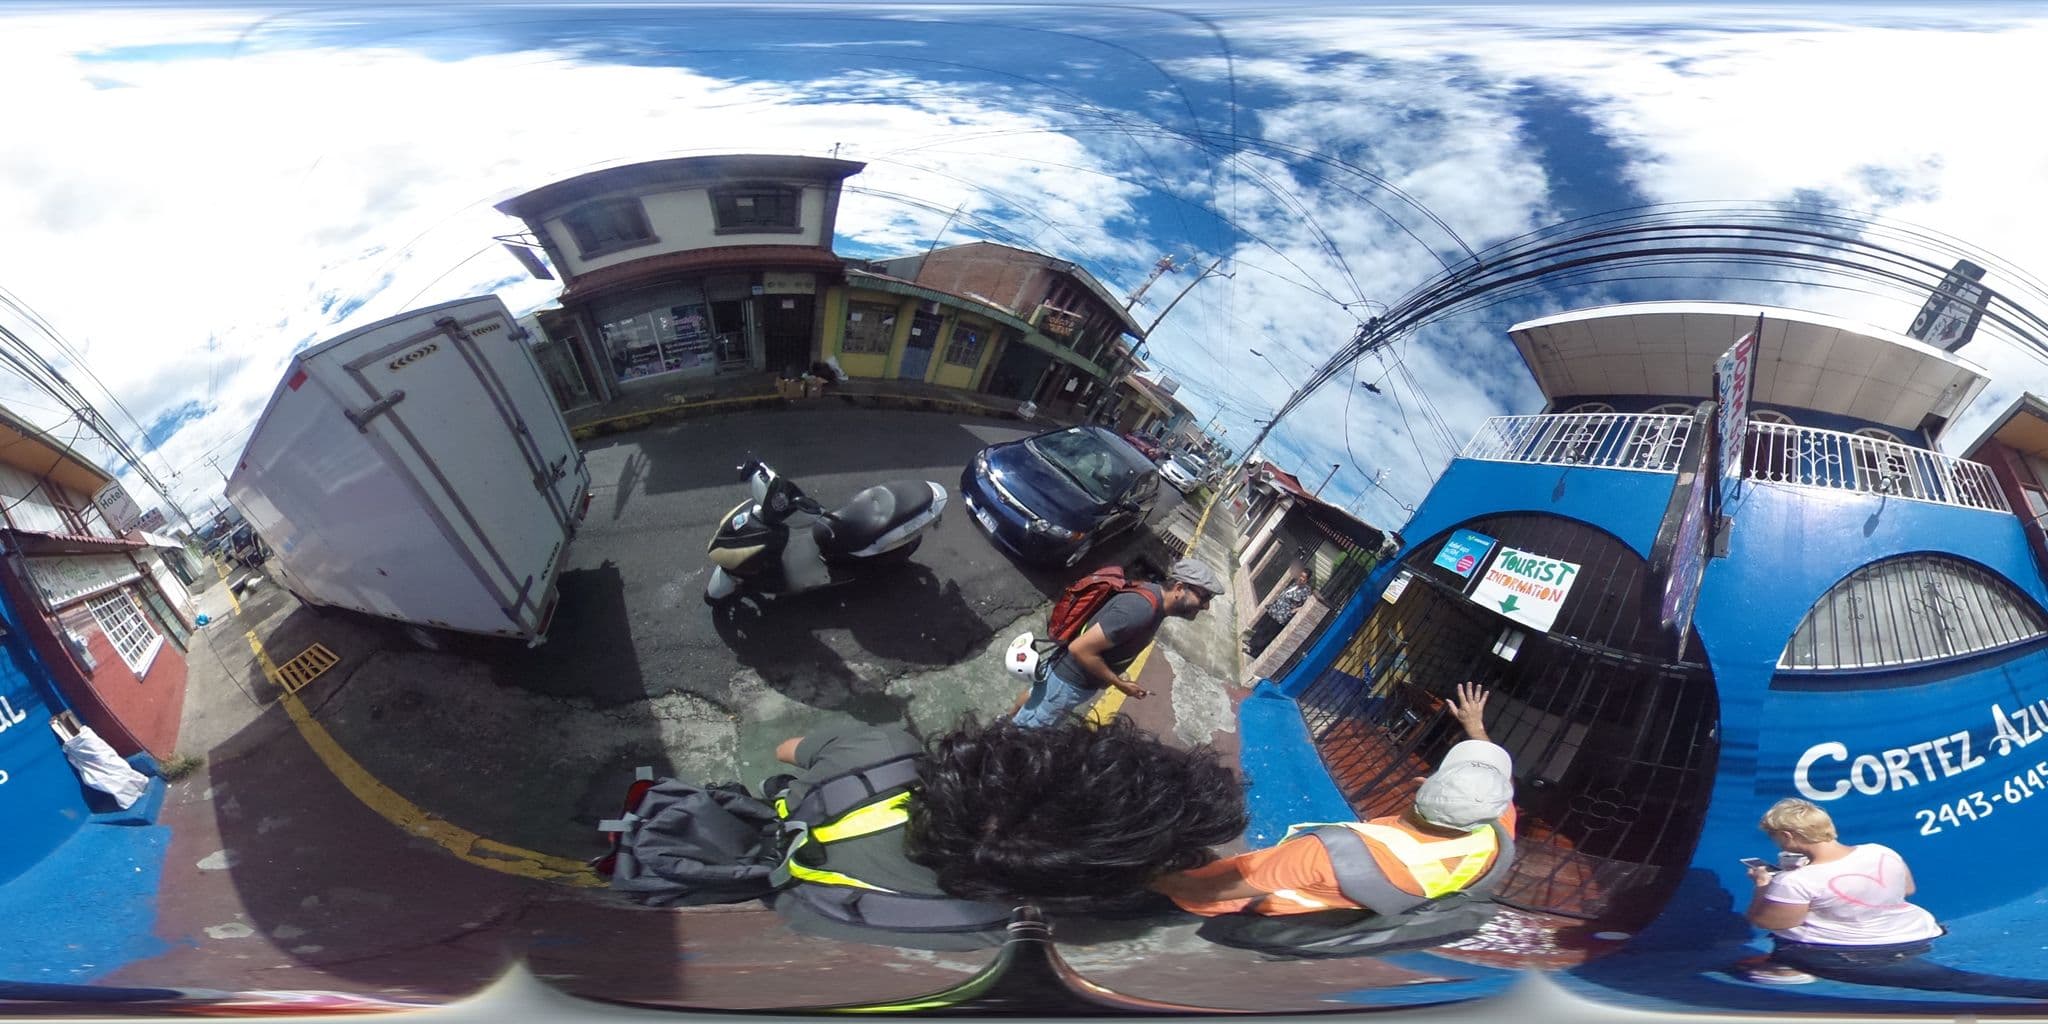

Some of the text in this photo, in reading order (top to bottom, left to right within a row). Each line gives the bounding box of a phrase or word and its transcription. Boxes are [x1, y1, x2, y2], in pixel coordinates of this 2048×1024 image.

[1732, 335, 1756, 419] DORM
[100, 488, 124, 510] Hotel
[1915, 762, 2048, 836] 2443-6145
